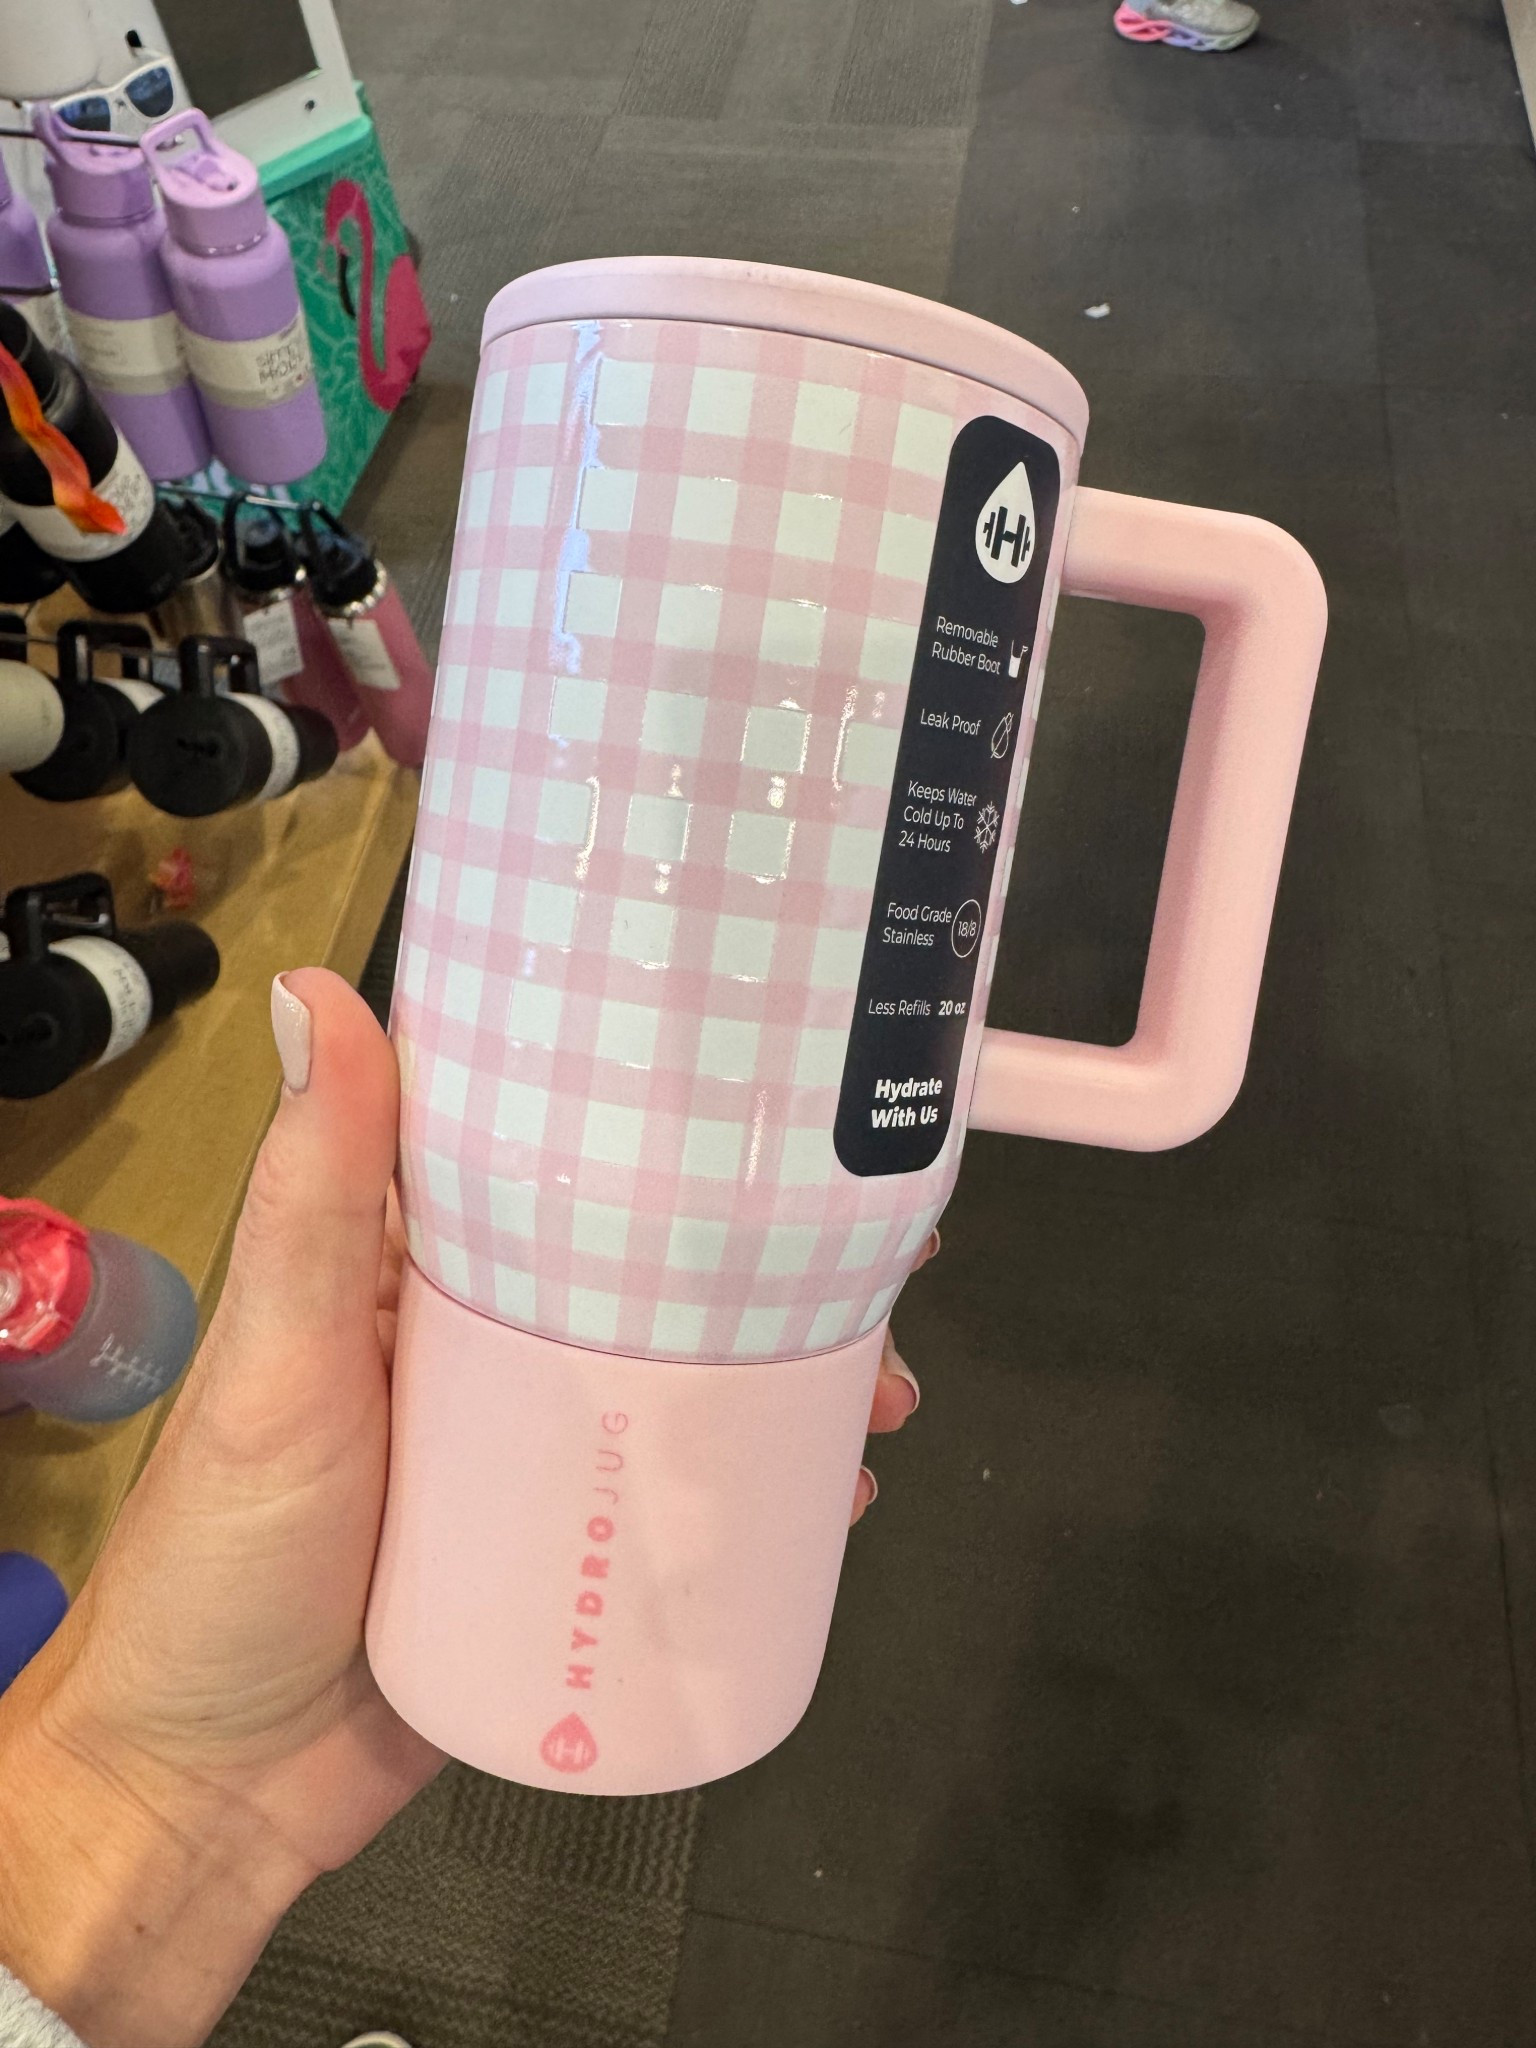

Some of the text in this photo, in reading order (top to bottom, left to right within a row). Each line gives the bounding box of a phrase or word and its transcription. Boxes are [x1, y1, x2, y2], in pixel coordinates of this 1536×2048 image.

[936, 615, 999, 648] Removable
[931, 641, 1001, 675] Rubber Boot
[920, 708, 982, 736] Leak Proof
[907, 780, 977, 807] Keeps Water
[903, 805, 965, 831] Cold Up To
[898, 830, 951, 853] 24 Hours
[886, 901, 952, 924] Food Grade
[882, 926, 935, 947] Stainless
[957, 918, 977, 939] 18/8
[868, 998, 968, 1017] Less Refills 20 oz
[874, 1077, 943, 1103] Hydrate
[871, 1105, 939, 1129] With Us
